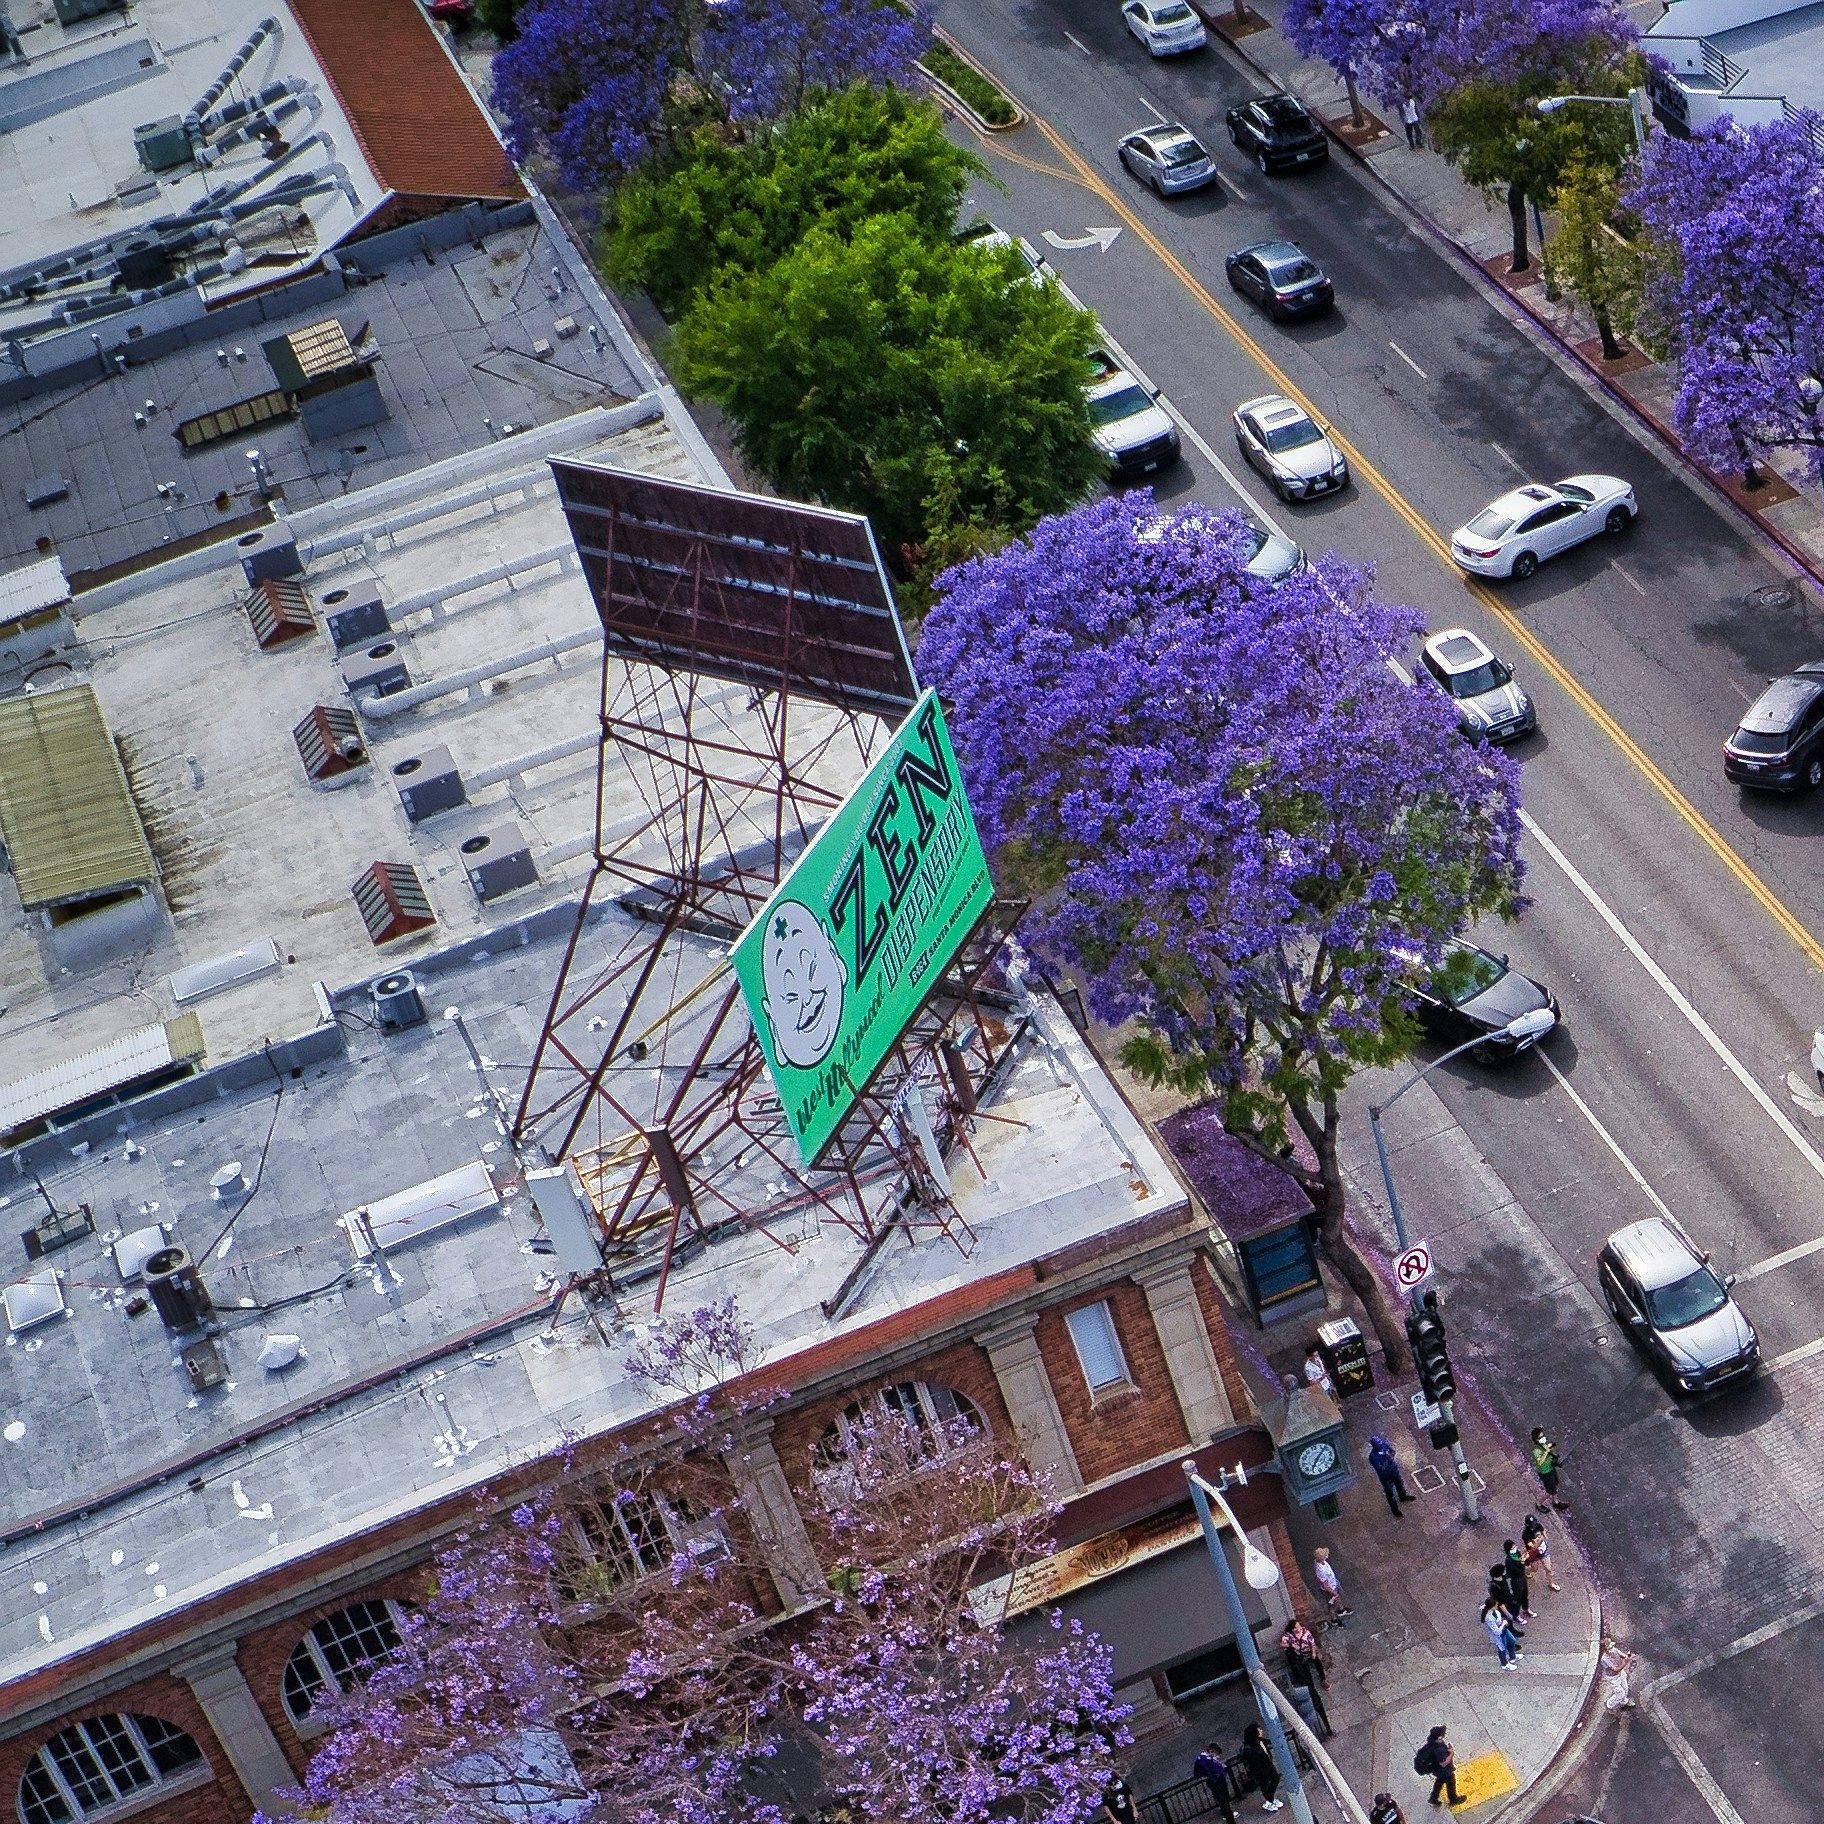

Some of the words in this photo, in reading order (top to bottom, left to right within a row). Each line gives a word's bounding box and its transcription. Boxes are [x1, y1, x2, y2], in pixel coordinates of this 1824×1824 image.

[831, 699, 952, 981] ZEN
[880, 787, 968, 992] DISPENSARY
[949, 890, 971, 928] MONICA
[970, 869, 986, 898] BLVD
[796, 1075, 827, 1136] West
[824, 977, 881, 1107] Hollywood
